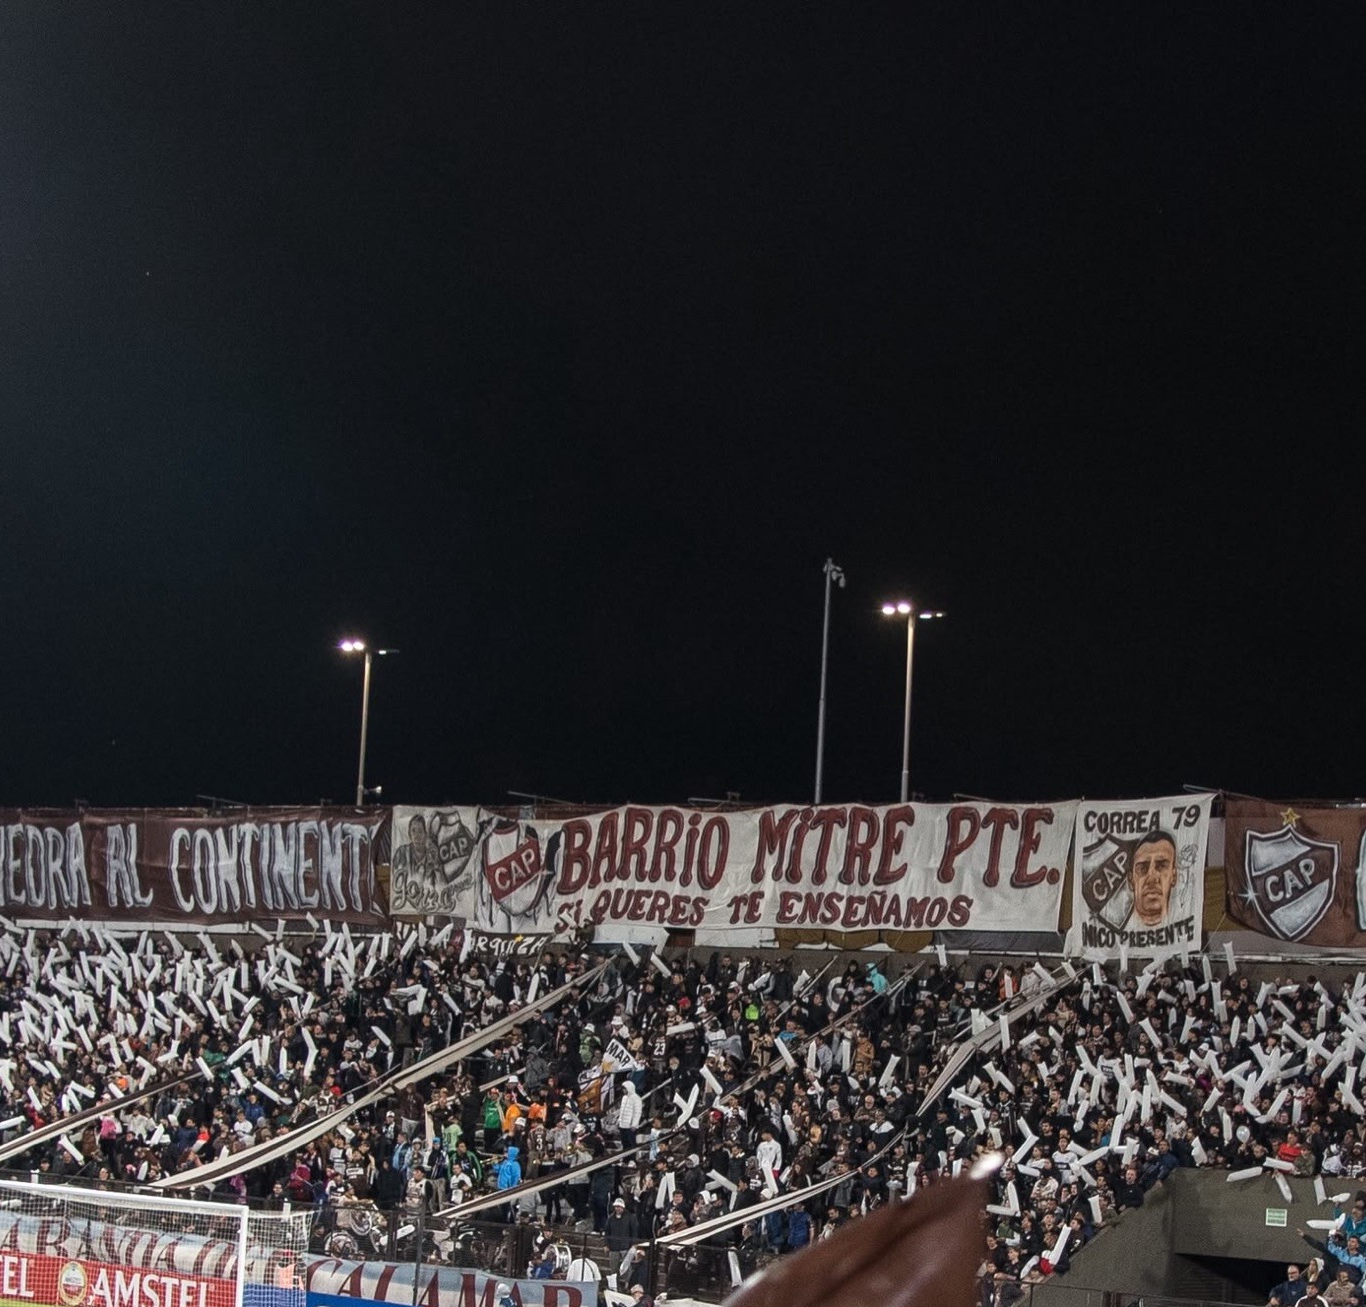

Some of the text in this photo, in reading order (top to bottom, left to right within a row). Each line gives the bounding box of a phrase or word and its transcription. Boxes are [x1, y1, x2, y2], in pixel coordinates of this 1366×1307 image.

[1084, 805, 1201, 834] CORREA 79
[169, 821, 383, 917] CONTINENT
[439, 838, 469, 861] CAP
[494, 848, 537, 891] CAP
[1092, 851, 1129, 901] CAP
[1264, 858, 1316, 903] CAP
[727, 890, 765, 924] TE
